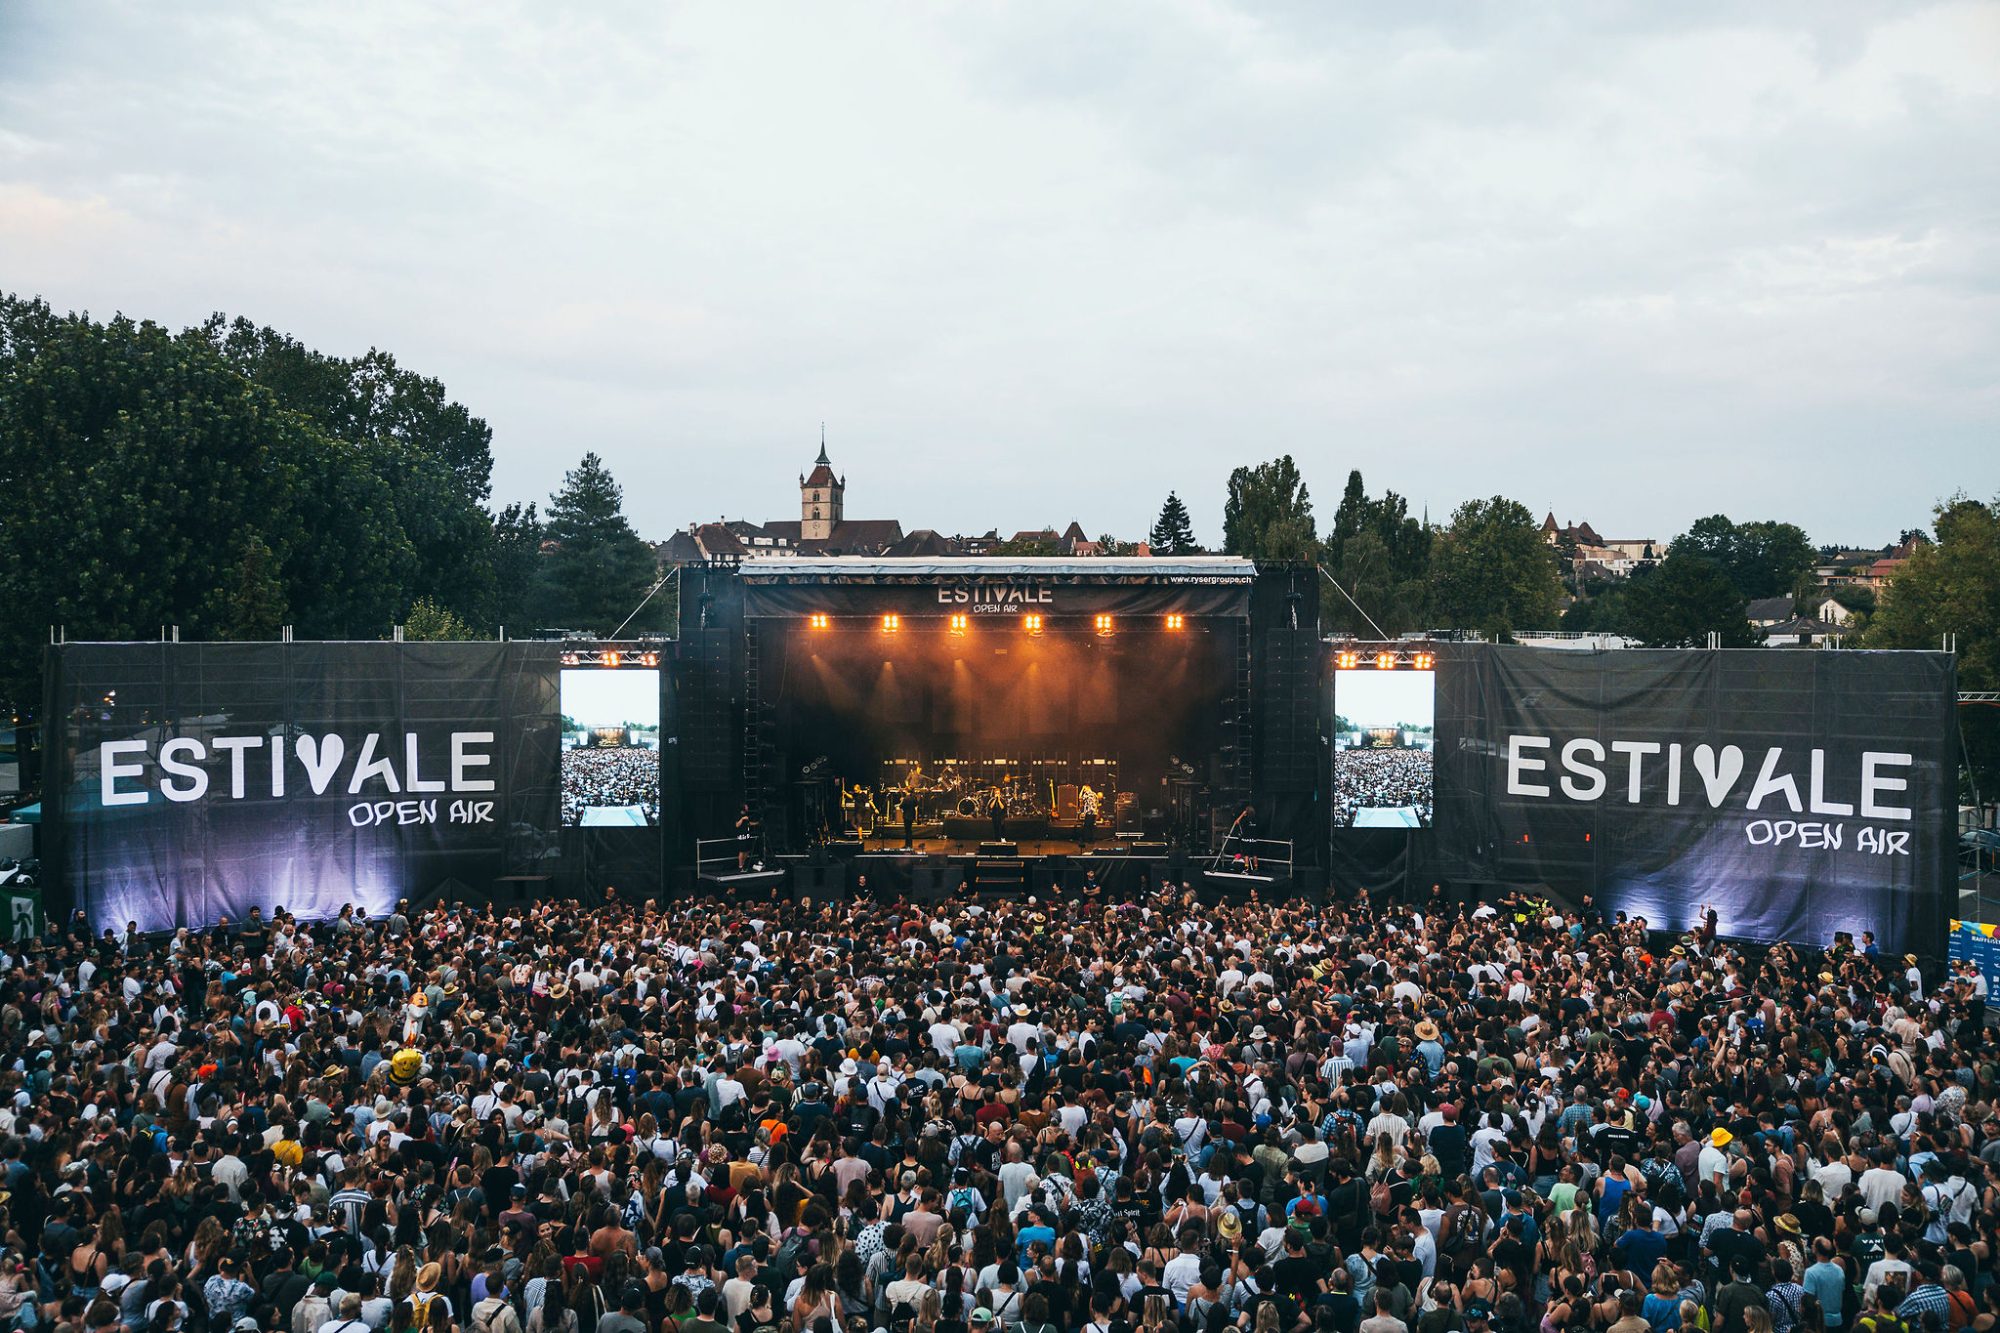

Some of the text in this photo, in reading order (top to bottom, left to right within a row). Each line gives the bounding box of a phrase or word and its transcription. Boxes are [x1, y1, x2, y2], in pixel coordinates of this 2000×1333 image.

[938, 585, 1053, 604] ESTIVALE
[1170, 576, 1252, 585] www.rysergroupe.ch
[973, 603, 1018, 614] OPEN AIR
[100, 731, 496, 806] ESTIVALE
[1507, 734, 1914, 821] ESTIVALE
[347, 799, 495, 827] OPEN AIR
[1745, 819, 1911, 856] OPEN AIR
